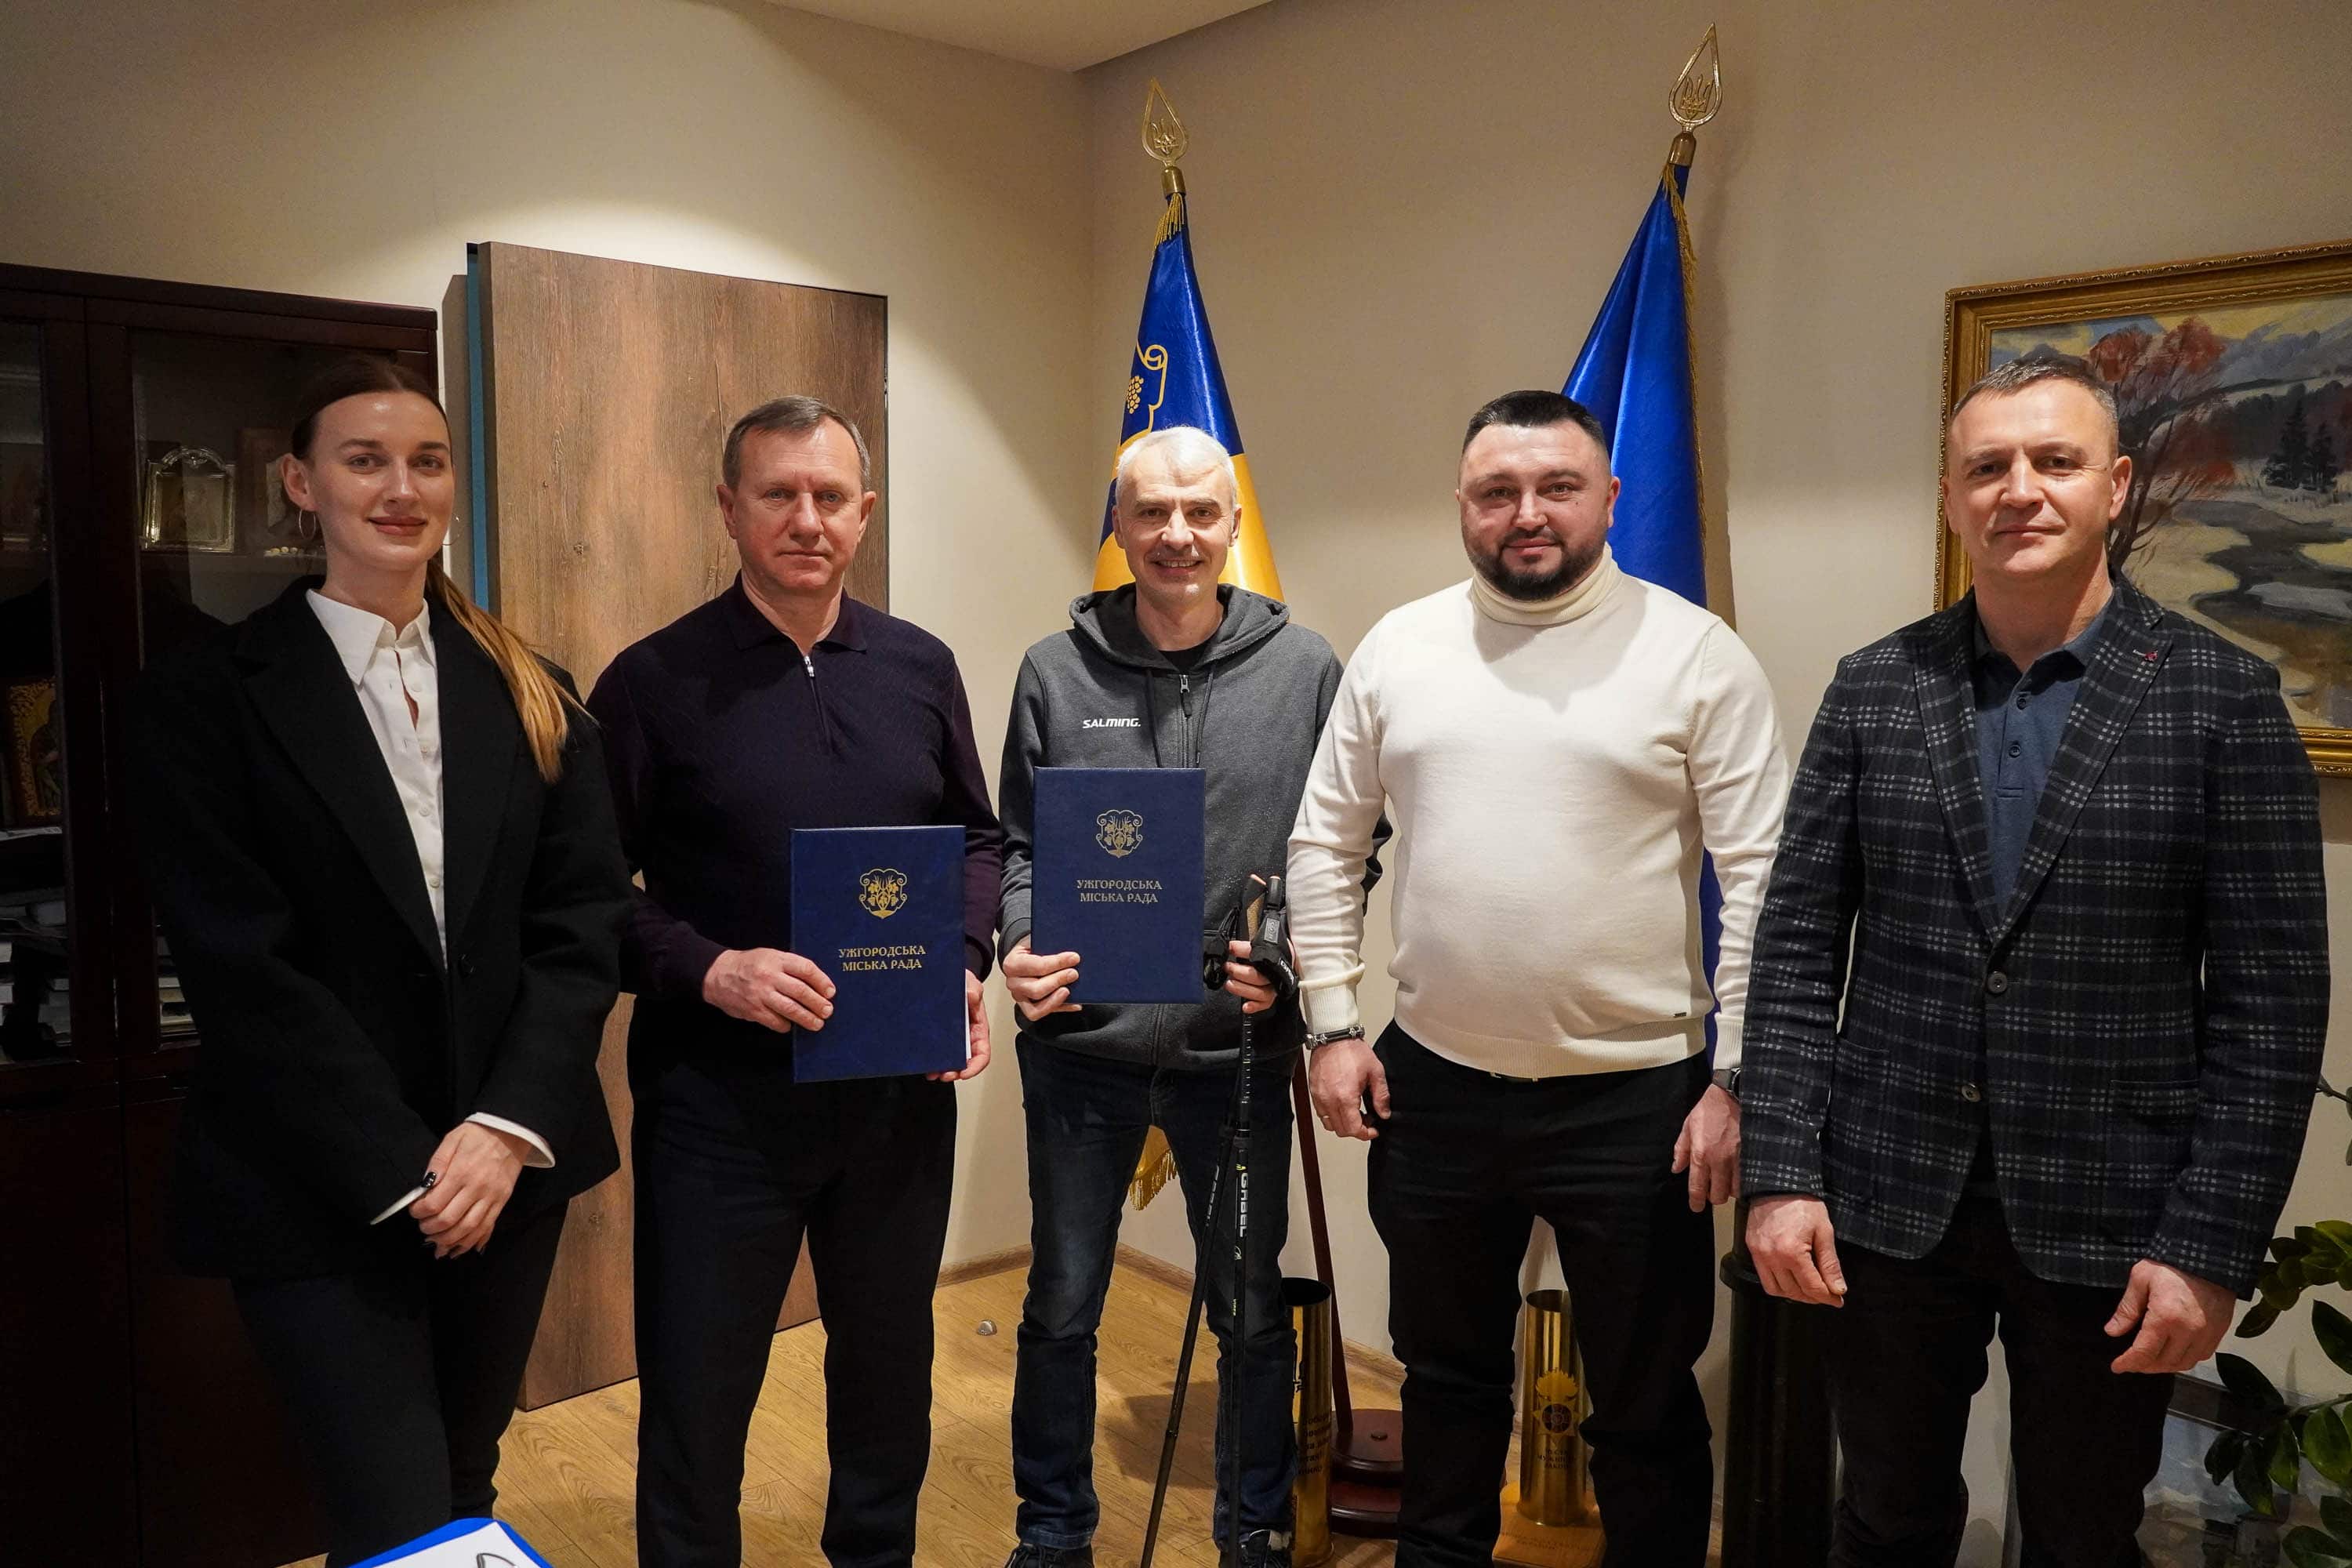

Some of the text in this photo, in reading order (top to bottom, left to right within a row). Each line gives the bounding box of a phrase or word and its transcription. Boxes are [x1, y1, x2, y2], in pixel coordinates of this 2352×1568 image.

[1076, 879, 1163, 891] УЖГОРОДСЬКА
[1080, 892, 1159, 904] МІСЬКА РАДА
[838, 945, 926, 958] УЖГОРОДСЬКА
[842, 959, 922, 971] МІСЬКА РАДА
